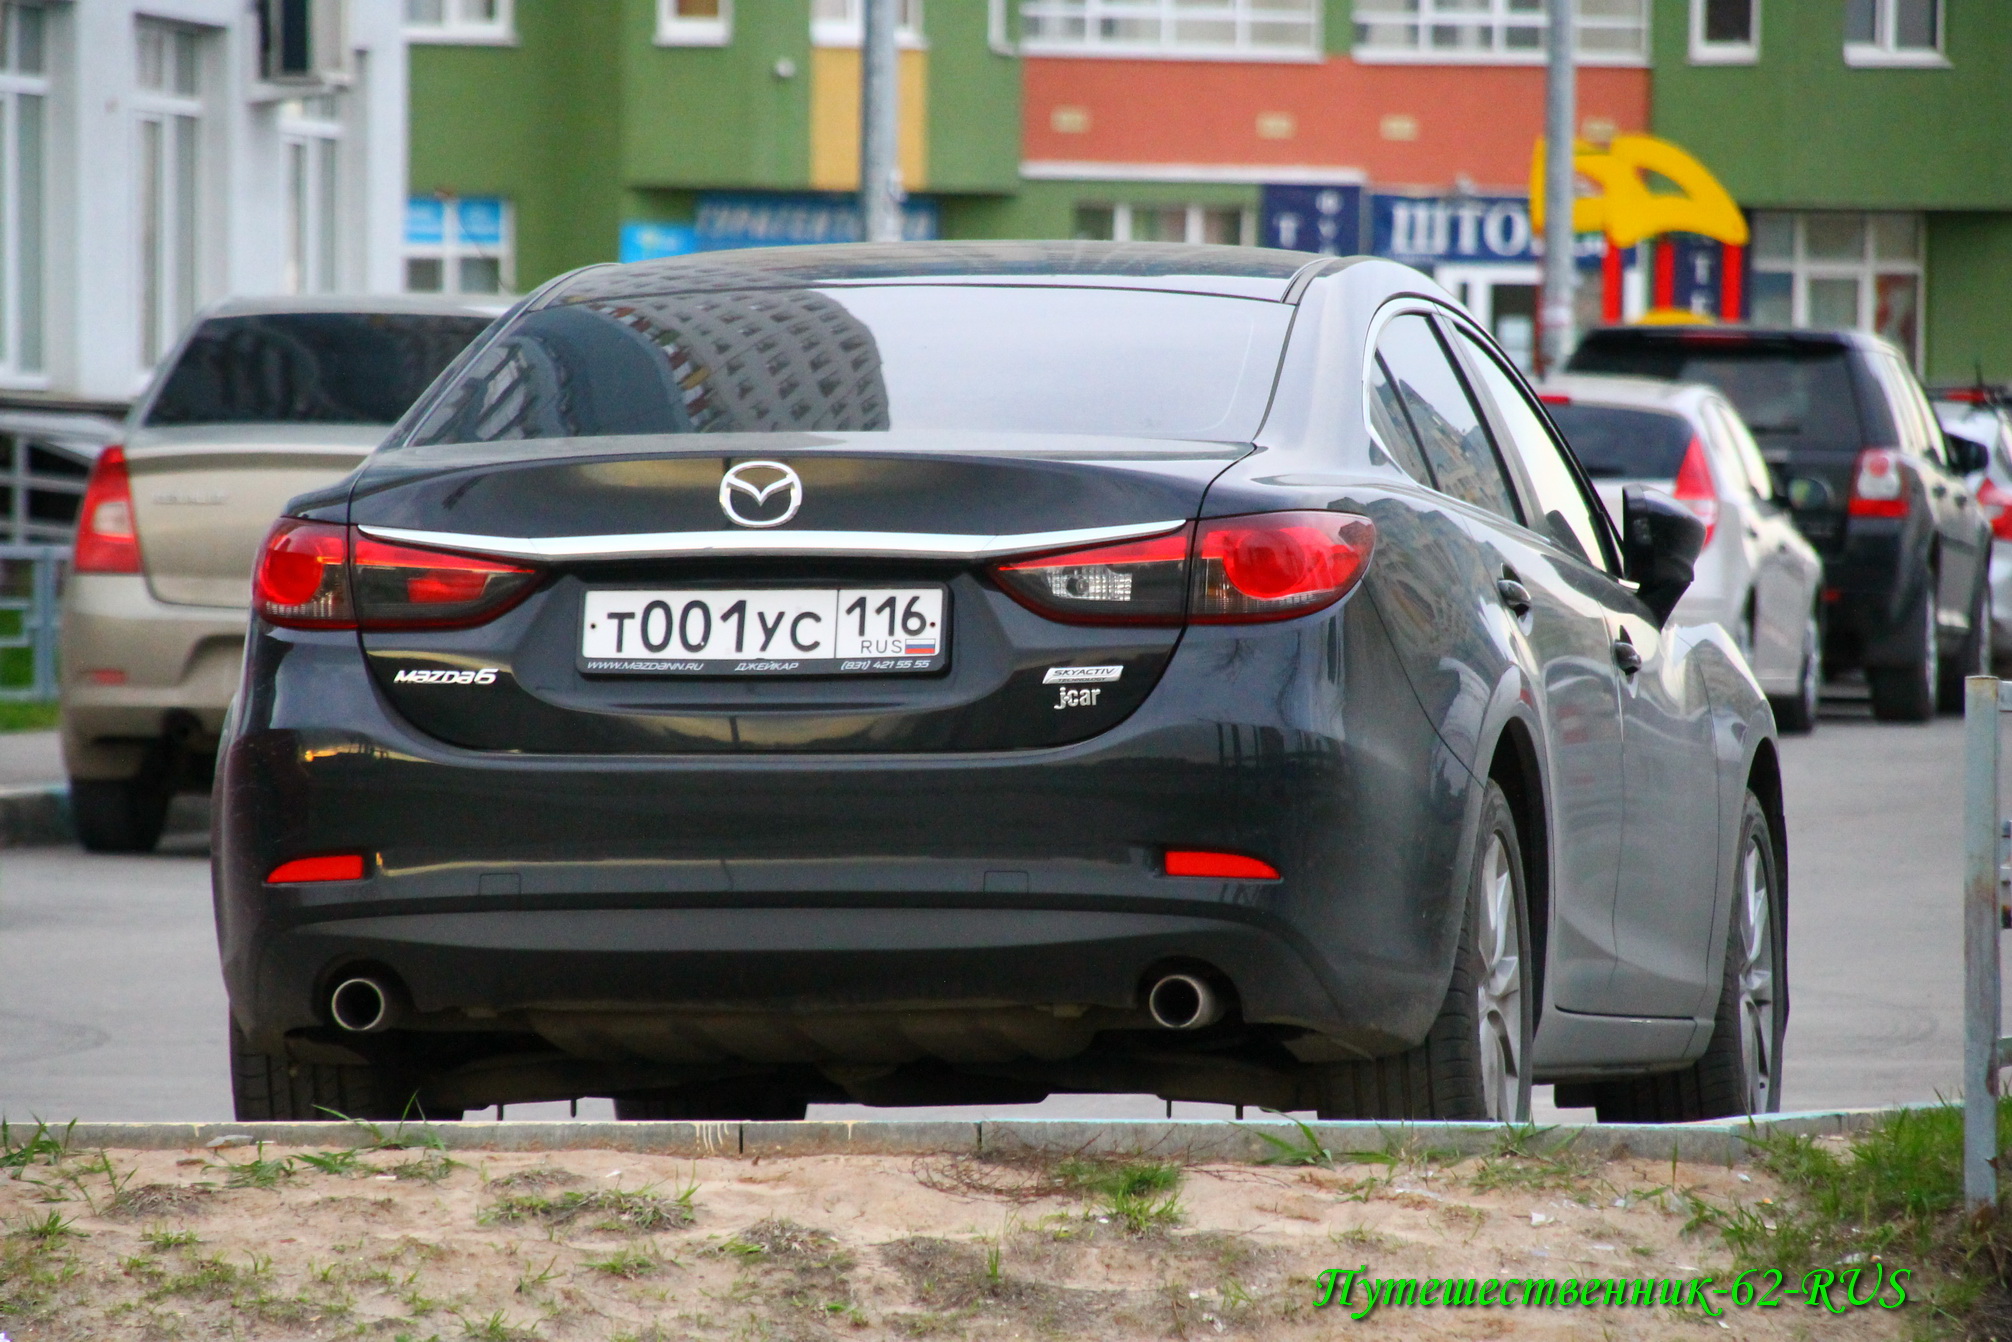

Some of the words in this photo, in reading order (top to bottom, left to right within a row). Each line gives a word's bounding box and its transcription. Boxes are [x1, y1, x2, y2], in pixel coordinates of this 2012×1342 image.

[845, 596, 927, 638] 116
[860, 639, 903, 654] RUS
[734, 661, 800, 671] ДЖЕЙКАР
[840, 660, 871, 671] (831)
[872, 660, 894, 670] 421
[895, 660, 912, 669] 55
[914, 659, 931, 669] 55
[1053, 668, 1116, 676] SKYACTIV
